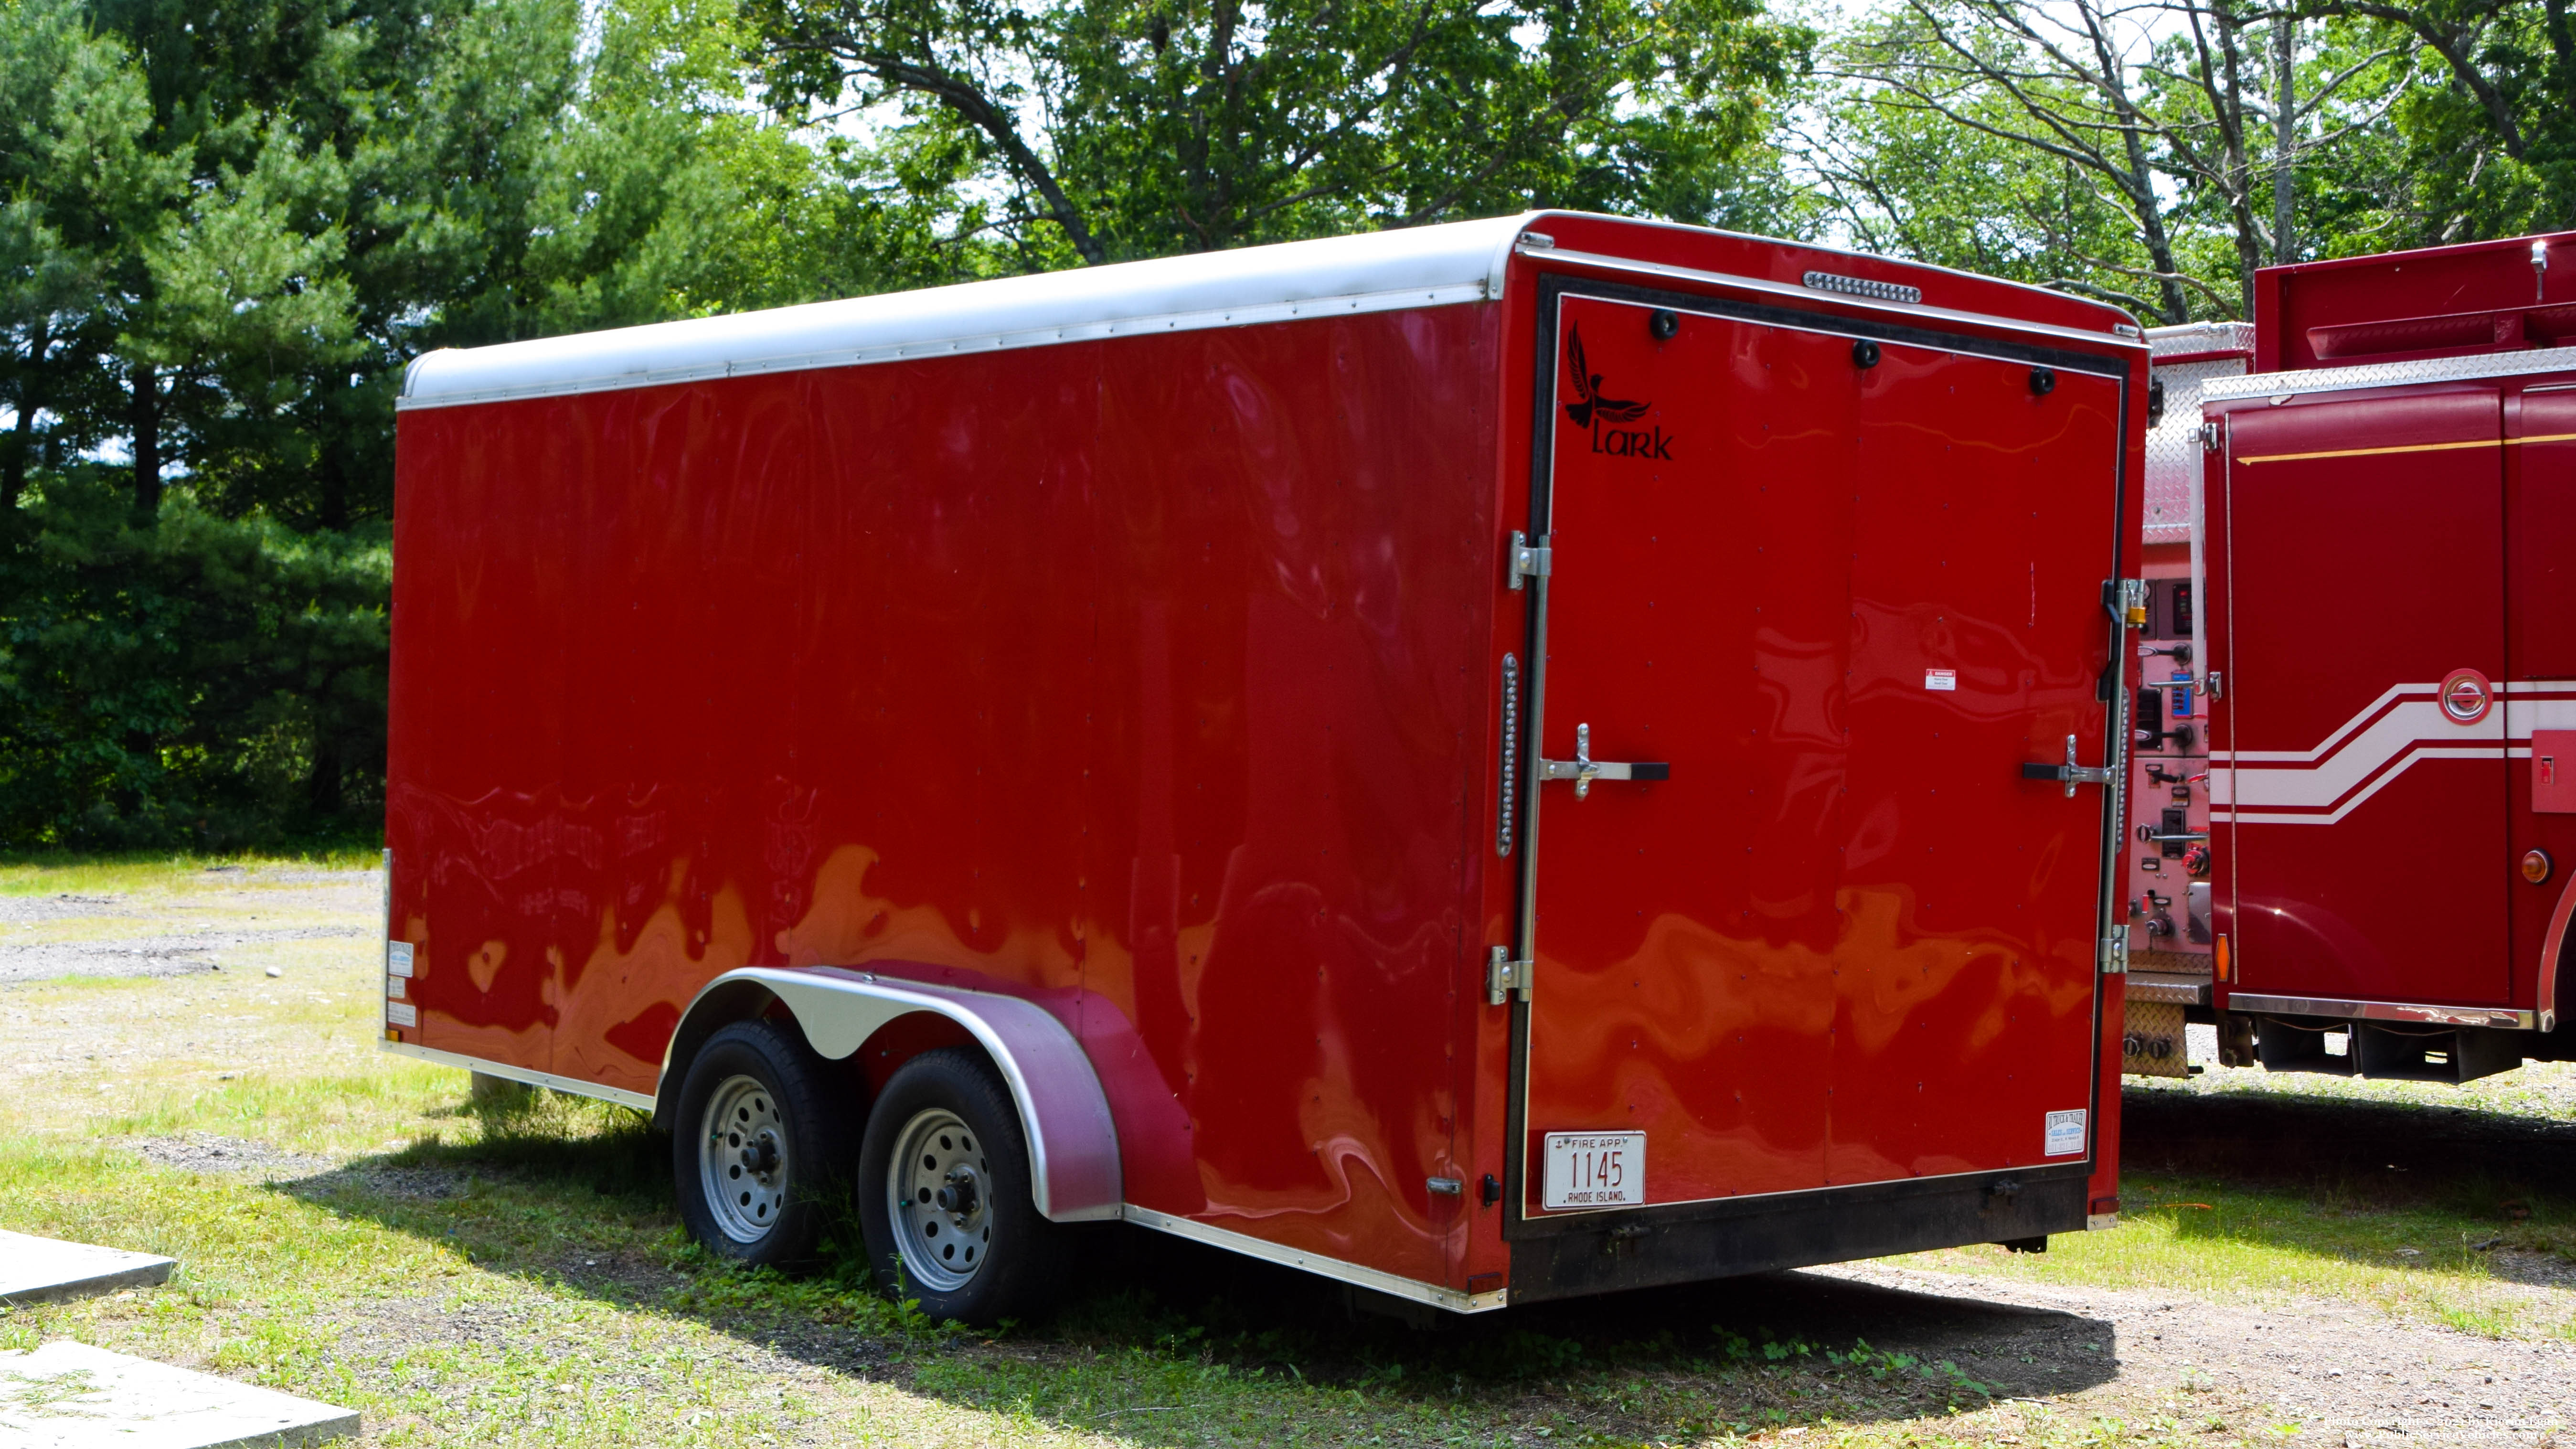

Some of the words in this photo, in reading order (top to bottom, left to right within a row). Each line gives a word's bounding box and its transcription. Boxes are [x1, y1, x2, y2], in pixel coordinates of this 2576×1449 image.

[2053, 1115, 2065, 1127] TRUCK
[2069, 1113, 2083, 1126] TRAILER
[1572, 1139, 1595, 1148] FIRE
[1572, 1151, 1622, 1188] 1145
[1568, 1192, 1592, 1203] RHODE
[1597, 1191, 1623, 1202] ISLAND
